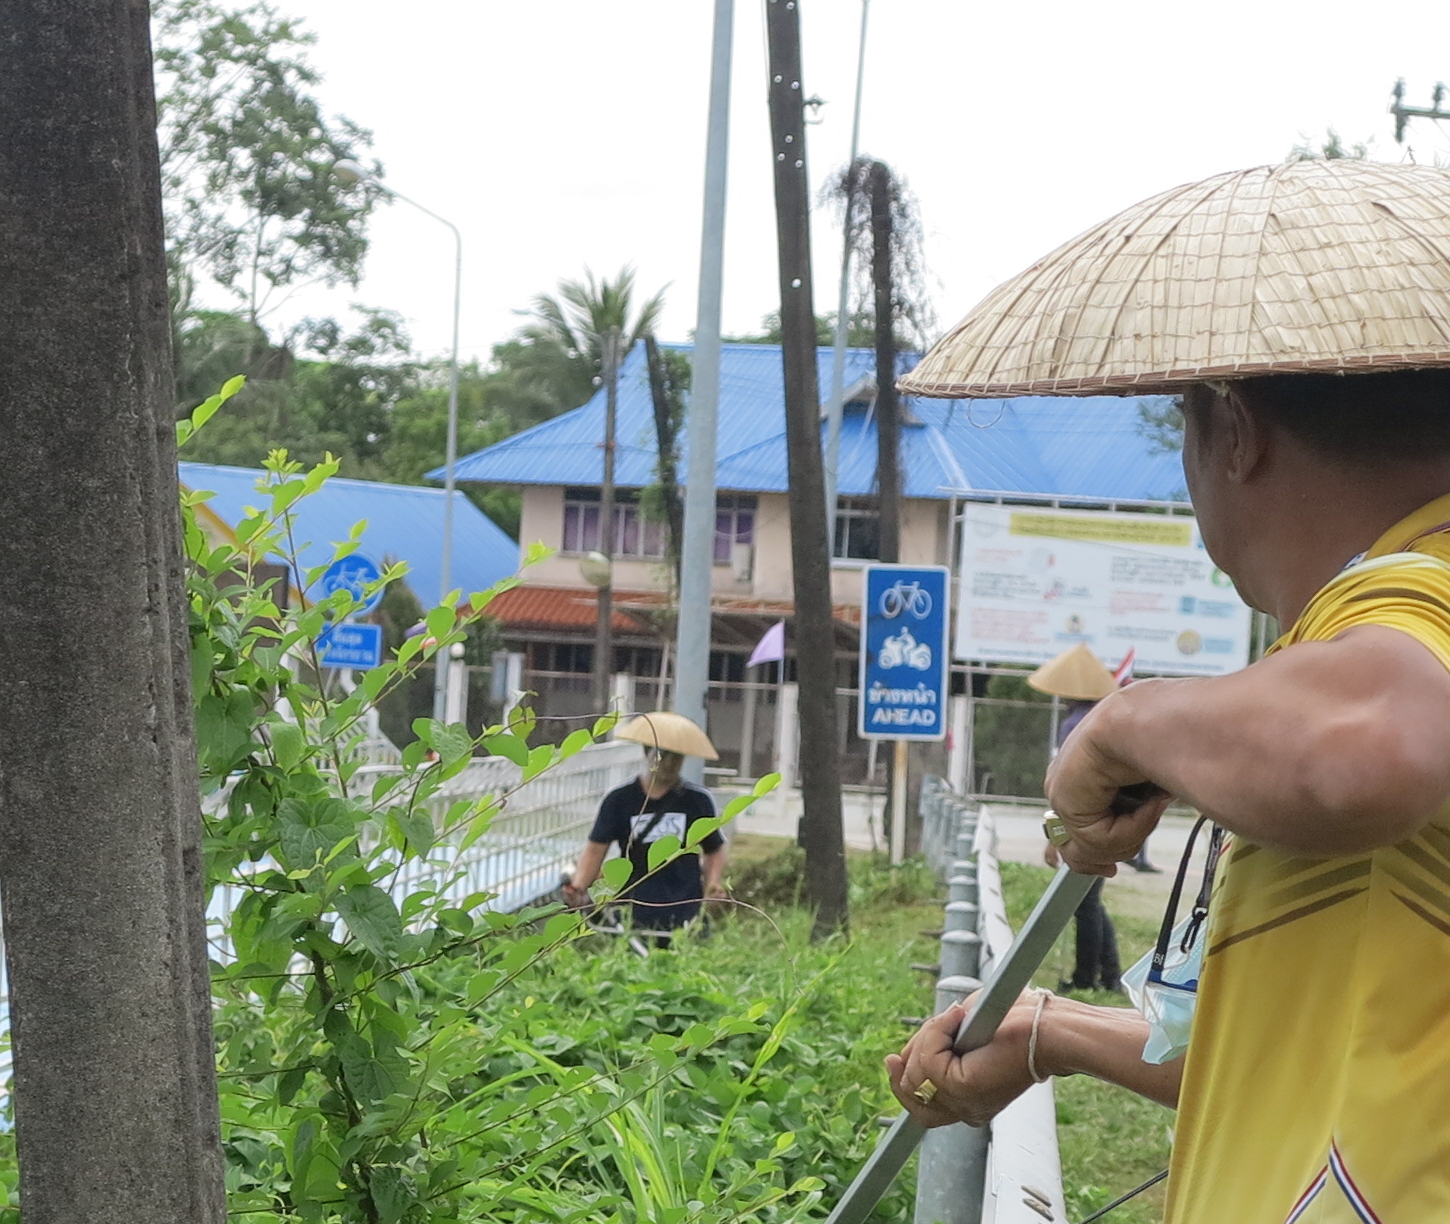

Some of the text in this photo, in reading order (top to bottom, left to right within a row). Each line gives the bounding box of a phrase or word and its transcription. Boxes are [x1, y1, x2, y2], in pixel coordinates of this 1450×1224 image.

[868, 680, 937, 705] ข้างหน้า
[871, 707, 937, 727] AHEAD
